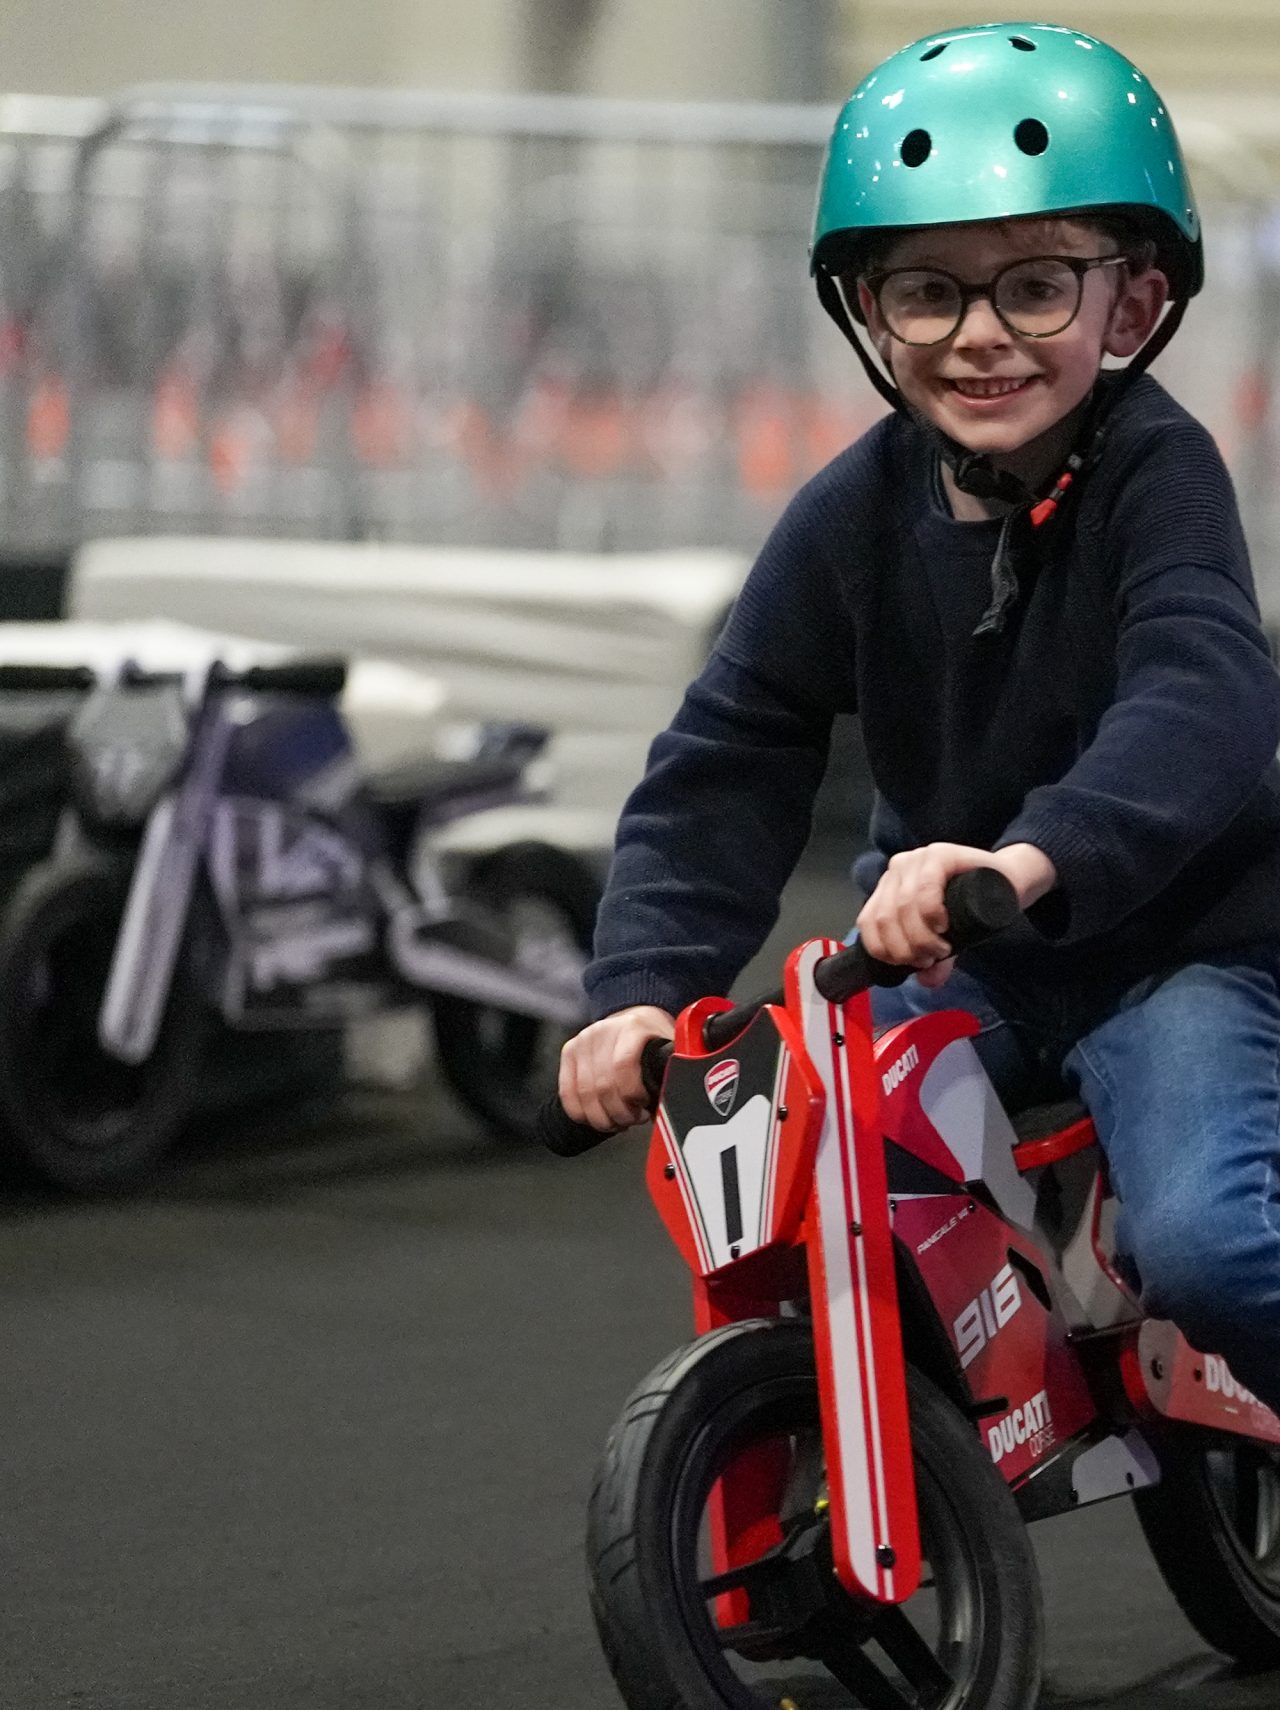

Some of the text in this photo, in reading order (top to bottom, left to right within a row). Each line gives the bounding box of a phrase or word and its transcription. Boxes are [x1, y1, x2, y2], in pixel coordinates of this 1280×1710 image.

[881, 1043, 919, 1097] DUCATI
[719, 1144, 743, 1246] 1
[953, 1263, 1022, 1370] 916
[988, 1389, 1052, 1464] DUCATI
